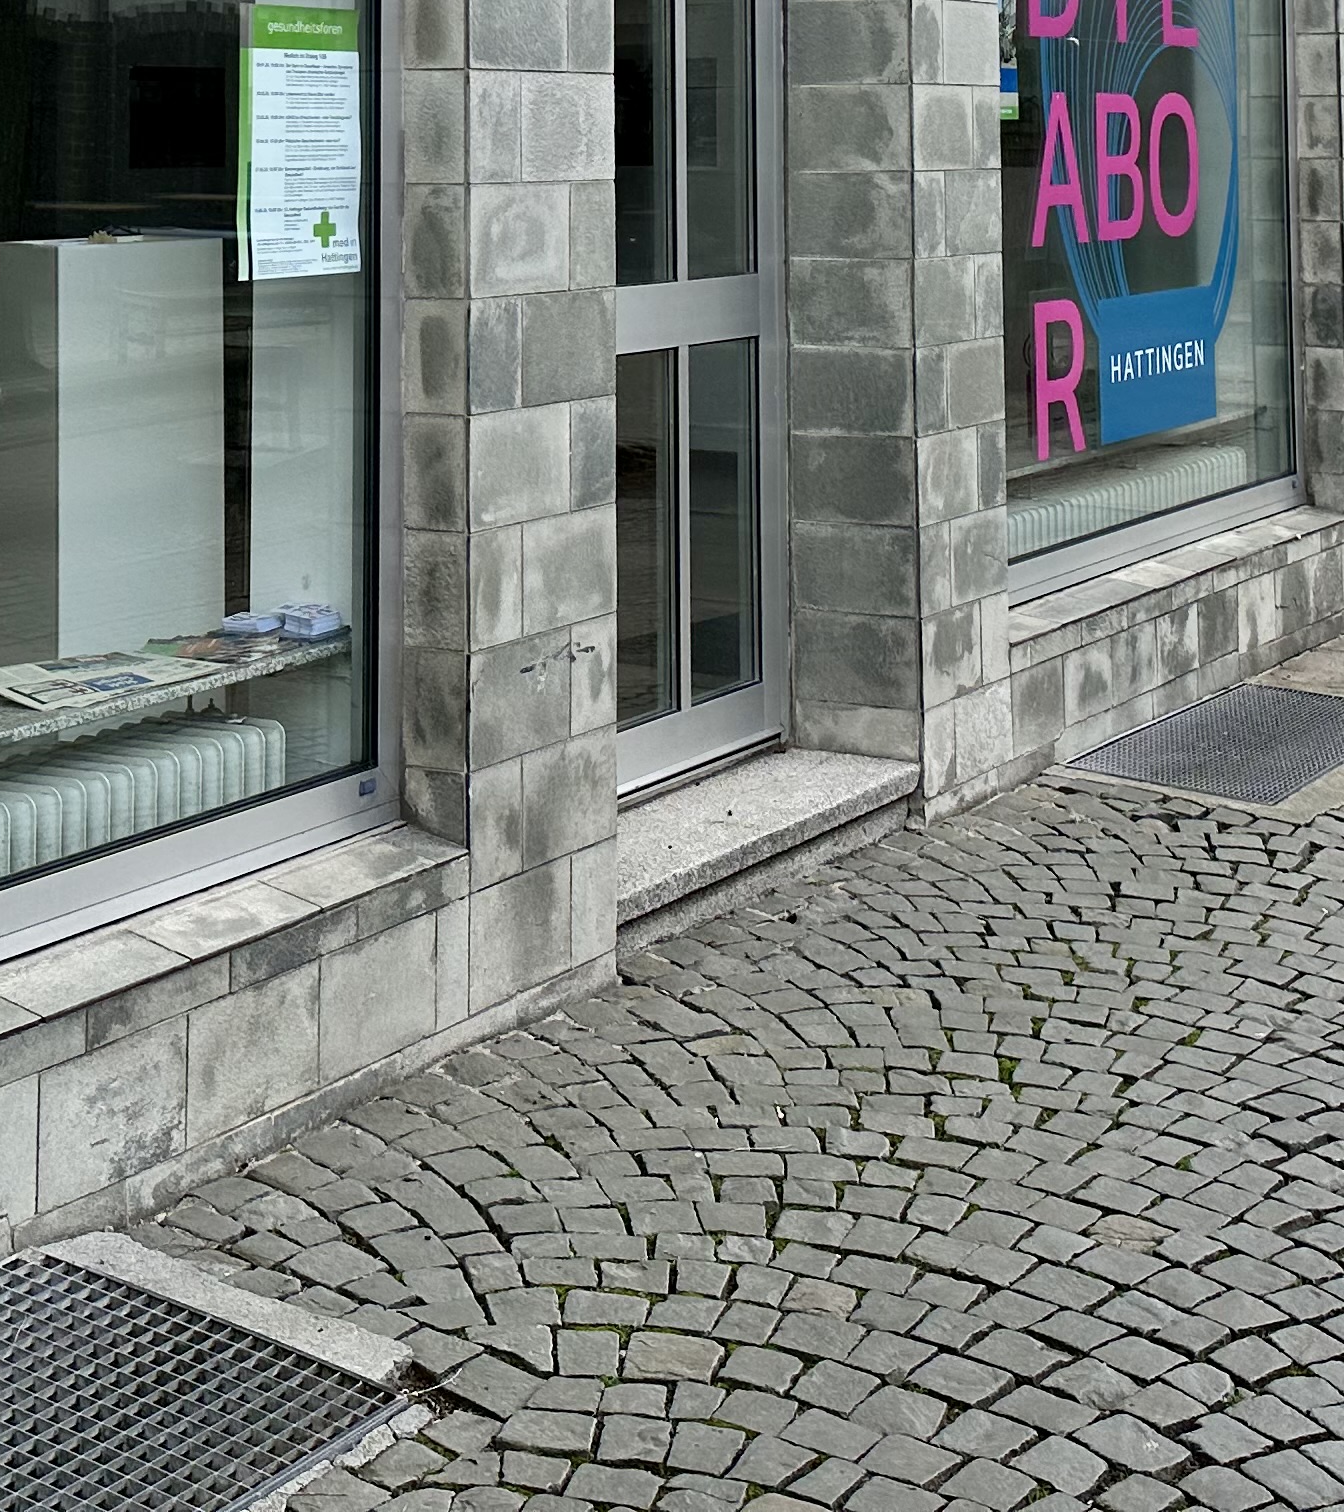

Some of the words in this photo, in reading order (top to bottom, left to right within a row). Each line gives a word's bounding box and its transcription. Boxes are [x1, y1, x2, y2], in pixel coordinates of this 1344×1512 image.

[267, 20, 343, 35] gesundheitsforen
[332, 237, 349, 248] med
[321, 252, 358, 264] Hattingen
[1110, 339, 1205, 384] HATTINGEN
[1032, 298, 1087, 462] R
